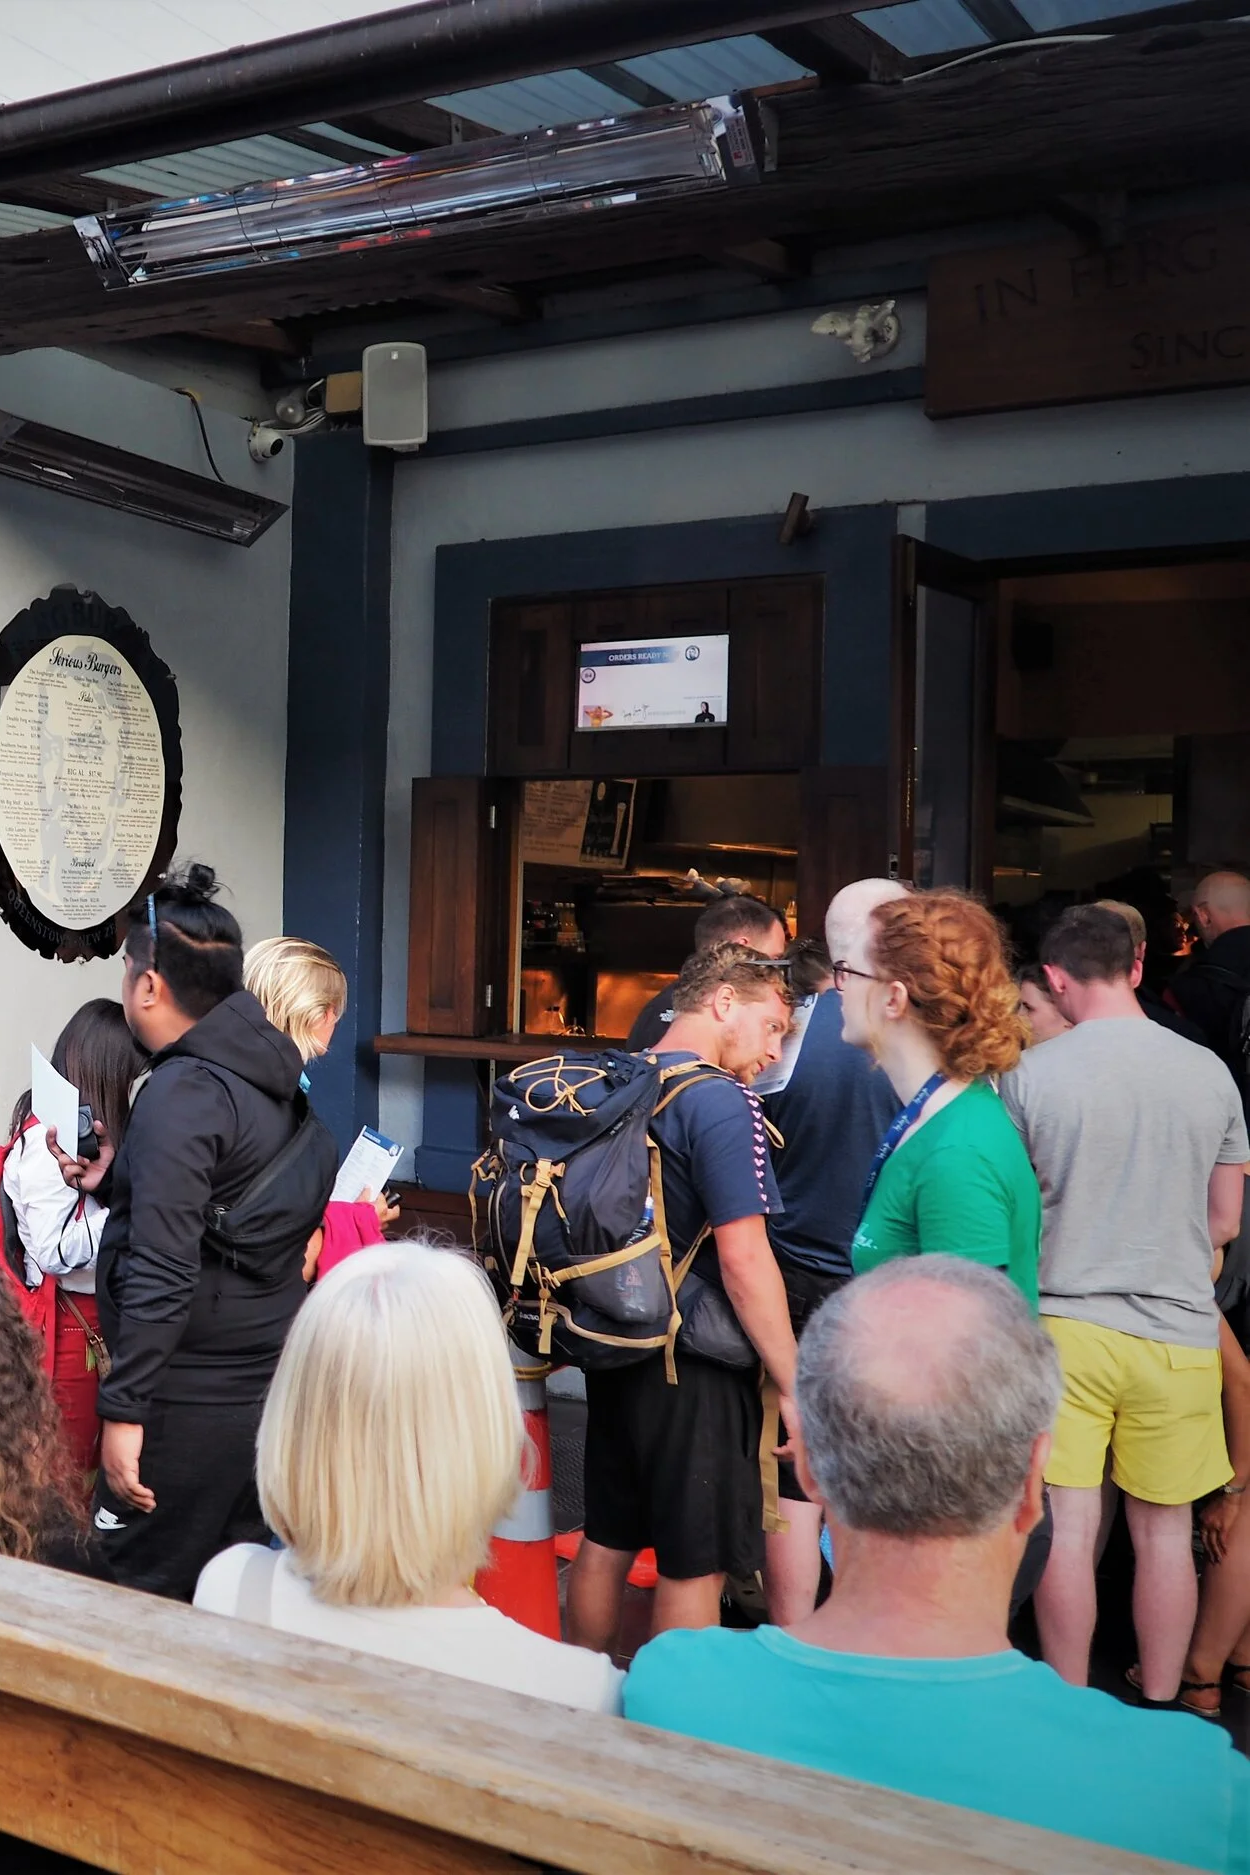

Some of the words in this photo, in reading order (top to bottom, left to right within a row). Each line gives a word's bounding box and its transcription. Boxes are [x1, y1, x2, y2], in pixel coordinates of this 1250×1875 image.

[974, 267, 1040, 326] IN
[1068, 225, 1218, 299] FERG
[49, 646, 83, 669] Serious
[85, 652, 122, 678] Burgers
[608, 653, 637, 662] ORDERS
